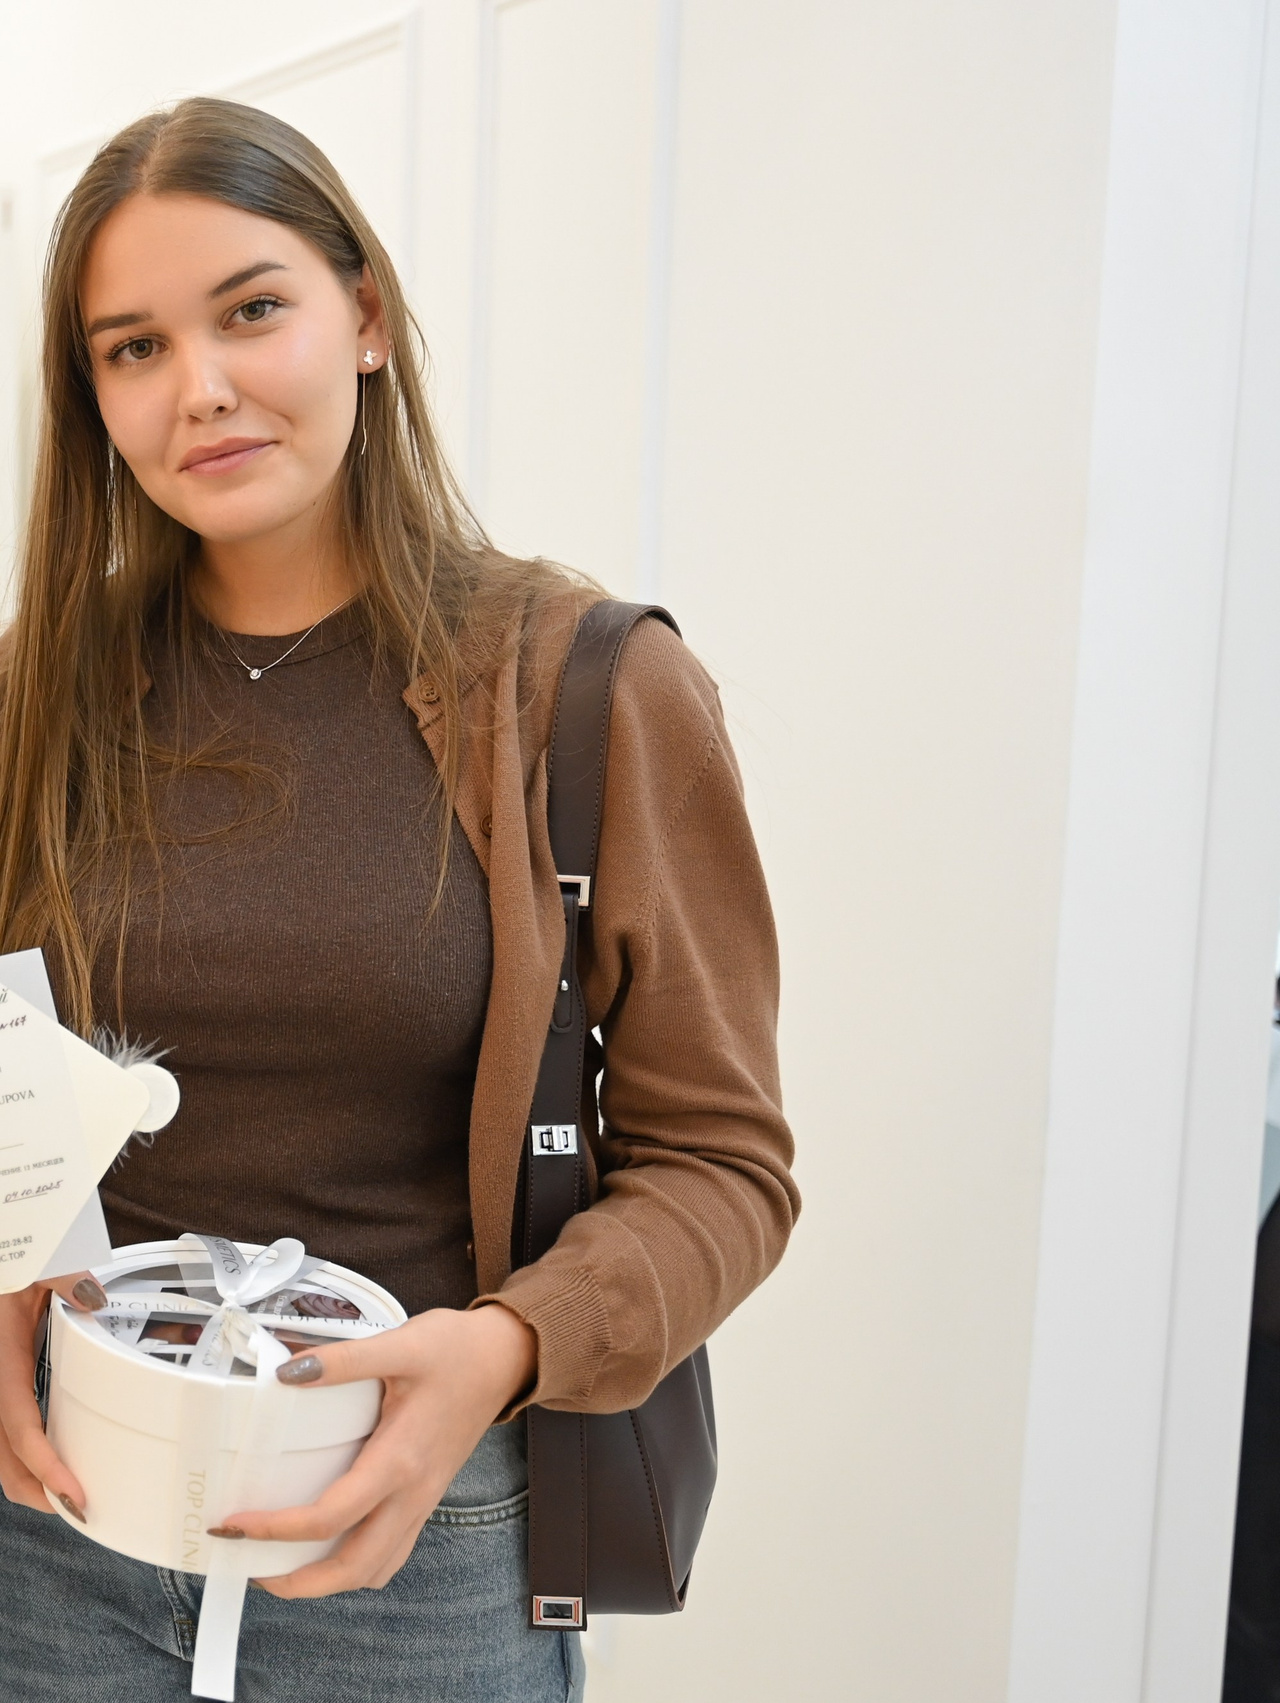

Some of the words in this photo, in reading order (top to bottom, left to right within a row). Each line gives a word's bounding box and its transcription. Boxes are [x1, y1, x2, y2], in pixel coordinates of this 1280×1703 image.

[32, 1157, 64, 1170] МЕСЯЦЕВ
[186, 1470, 206, 1508] TOP
[181, 1513, 202, 1571] CLINI
